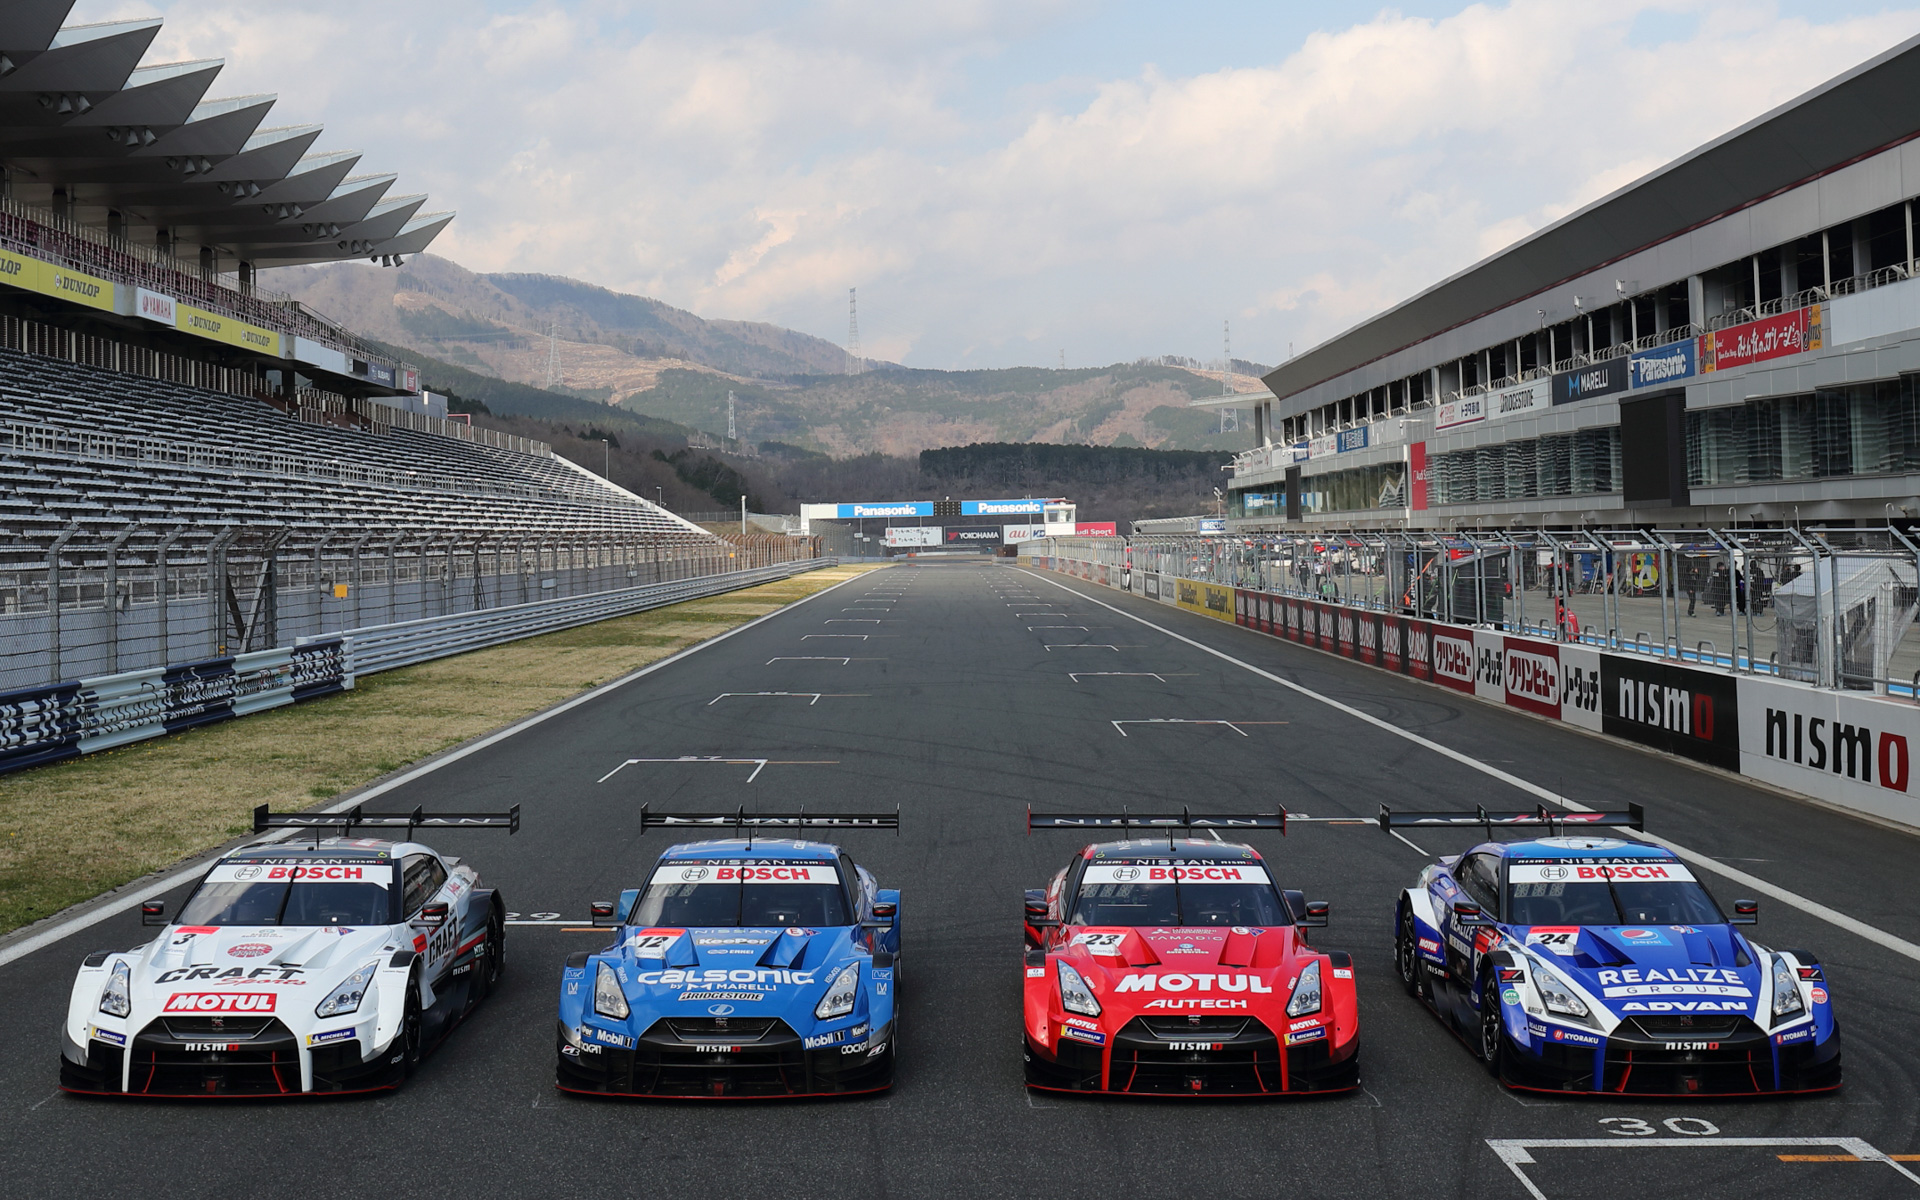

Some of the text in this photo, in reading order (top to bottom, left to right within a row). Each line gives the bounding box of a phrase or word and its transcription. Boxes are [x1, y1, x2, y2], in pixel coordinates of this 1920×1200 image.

[0, 259, 21, 276] LOP
[62, 276, 100, 298] DUNLOP
[149, 294, 172, 320] YAMAHA
[193, 315, 221, 333] DUNLOP
[246, 330, 271, 347] DUNLOP
[1640, 353, 1687, 382] Panasonic
[377, 369, 391, 382] SUBARU
[1580, 369, 1609, 393] MARELLI
[1500, 389, 1534, 413] BRIDGESTONE
[854, 504, 917, 517] Panasonic
[978, 501, 1041, 514] Panasonic
[958, 531, 999, 540] YOKOHAMA
[1009, 530, 1029, 539] au
[1033, 529, 1046, 538] KD
[1075, 528, 1112, 537] udi Sport
[1436, 640, 1471, 676] クリンビュー
[1509, 655, 1556, 698] クリンビュー
[267, 867, 363, 879] BOSCH
[716, 868, 811, 880] BOSCH
[1149, 868, 1242, 880] BOSCH
[1577, 867, 1670, 879] BOSCH
[172, 933, 197, 945] 3
[428, 916, 458, 968] CRAFT
[638, 936, 670, 948] 12
[699, 938, 769, 946] KeePer
[1085, 934, 1120, 946] 23
[1418, 938, 1438, 952] MOTUL
[1539, 933, 1570, 945] 24
[154, 967, 304, 984] CRAFT
[1597, 968, 1745, 986] REALIZE
[1114, 974, 1273, 994] MOTUL
[1626, 985, 1730, 994] GROUP
[167, 994, 273, 1010] MOTUL
[680, 992, 763, 1001] BRIDGESTONE
[1143, 999, 1247, 1009] AUTECH
[1621, 1002, 1749, 1011] ADVAN
[1066, 1017, 1098, 1031] MOTUL
[1289, 1018, 1320, 1031] MOTUL
[101, 1030, 124, 1042] MICHELIN
[321, 1031, 351, 1040] MICHELIN
[597, 1029, 624, 1046] Mobil
[804, 1032, 834, 1049] Mobil
[1073, 1030, 1101, 1041] MICHELIN
[1296, 1030, 1322, 1040] MICHELIN
[1564, 1032, 1599, 1045] KYORAKU
[1782, 1029, 1808, 1041] KYORAKU
[1598, 1116, 1721, 1136] 30
